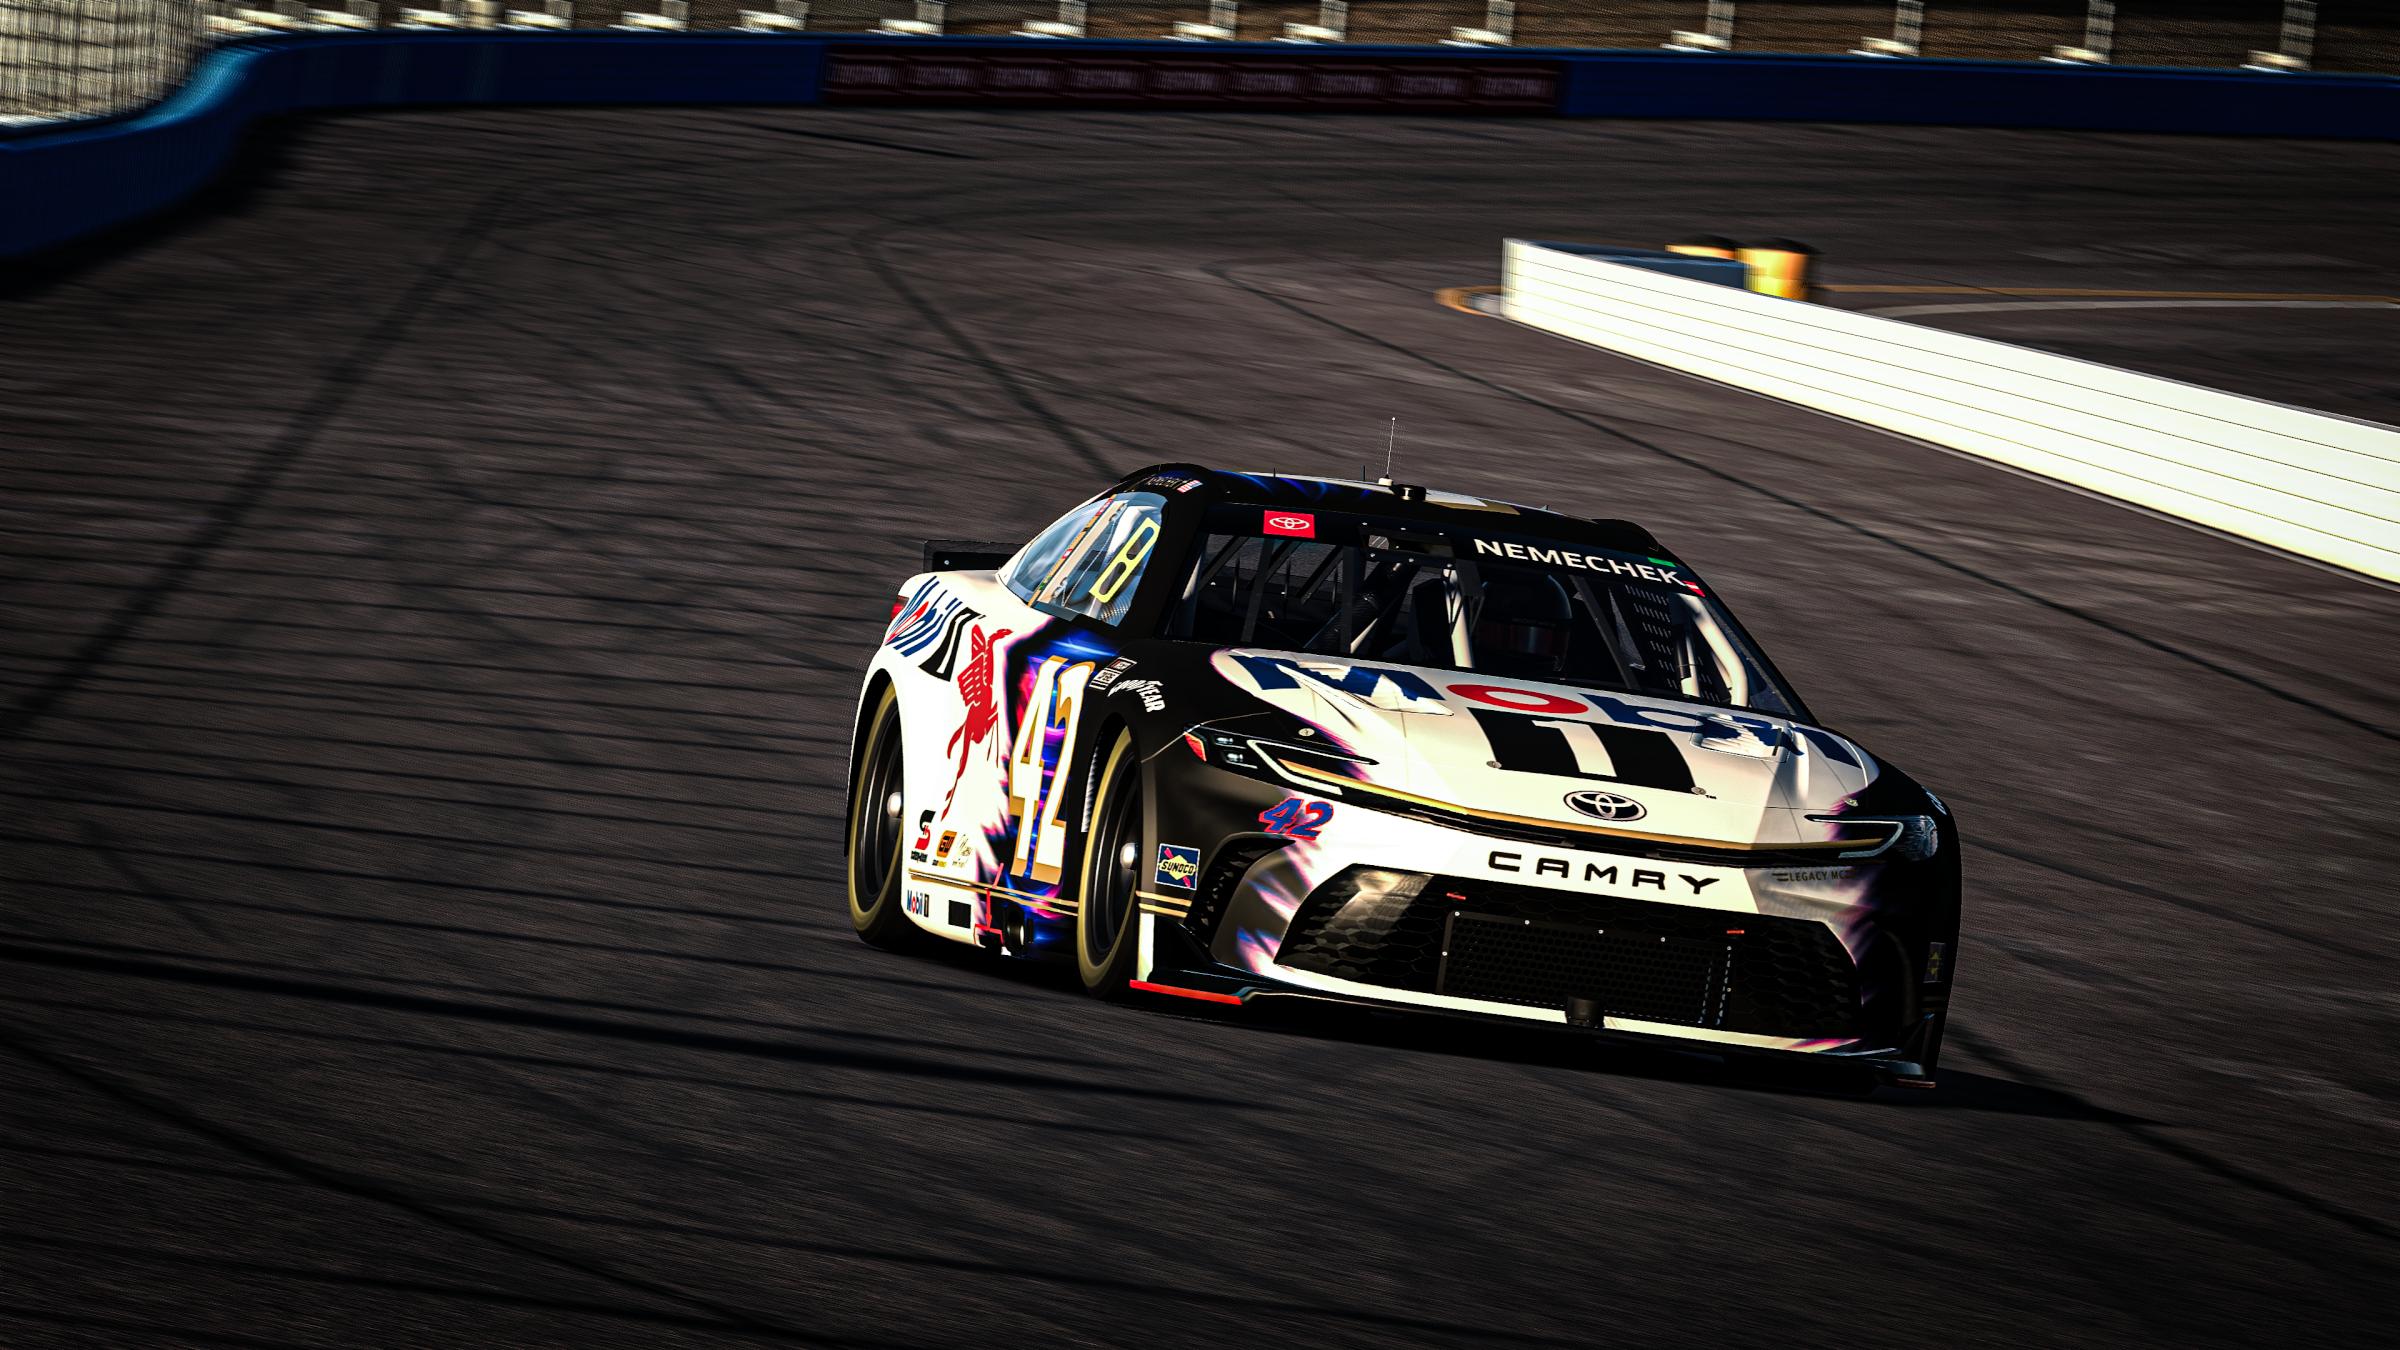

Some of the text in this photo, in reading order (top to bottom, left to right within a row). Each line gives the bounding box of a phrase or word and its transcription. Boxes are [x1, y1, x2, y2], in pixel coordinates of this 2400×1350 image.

[1473, 538, 1687, 587] NEMECHEK
[1008, 655, 1096, 885] 42
[1258, 797, 1335, 841] 42
[1160, 860, 1196, 875] SUNOCO
[1487, 850, 1720, 895] CAMRY
[1788, 871, 1828, 882] LEGACY
[906, 889, 923, 915] Mobil
